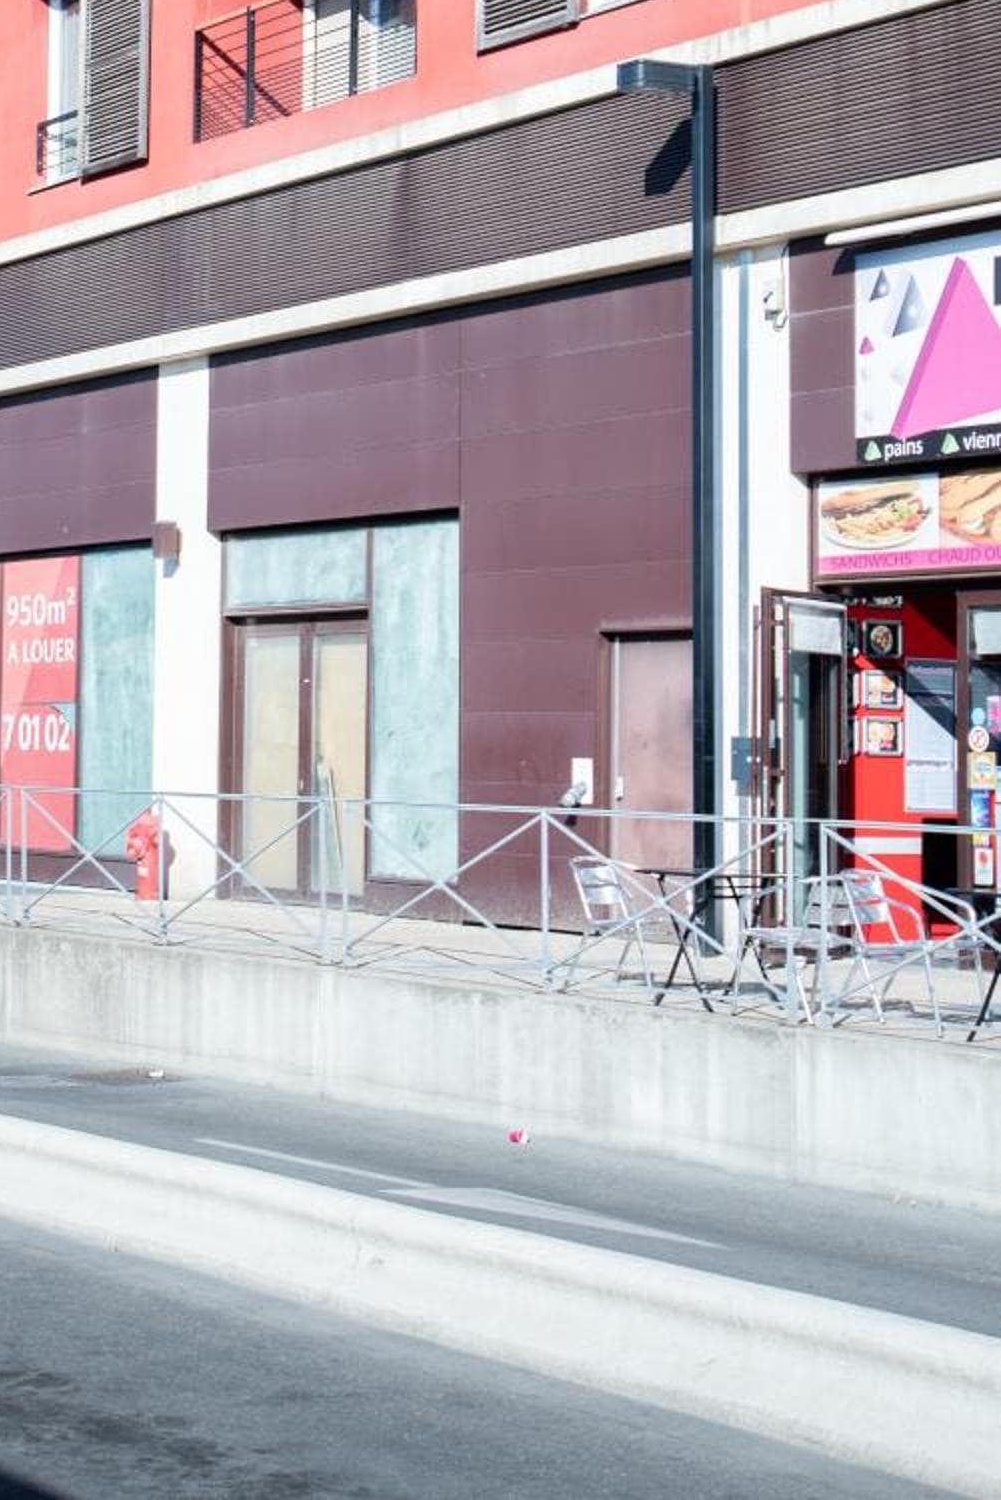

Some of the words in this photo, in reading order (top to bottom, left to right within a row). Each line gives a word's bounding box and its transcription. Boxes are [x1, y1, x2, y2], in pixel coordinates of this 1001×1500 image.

[884, 436, 924, 462] pains
[7, 641, 19, 664] A
[22, 636, 75, 664] LOUER
[18, 713, 41, 752] 01
[44, 711, 71, 753] 02
